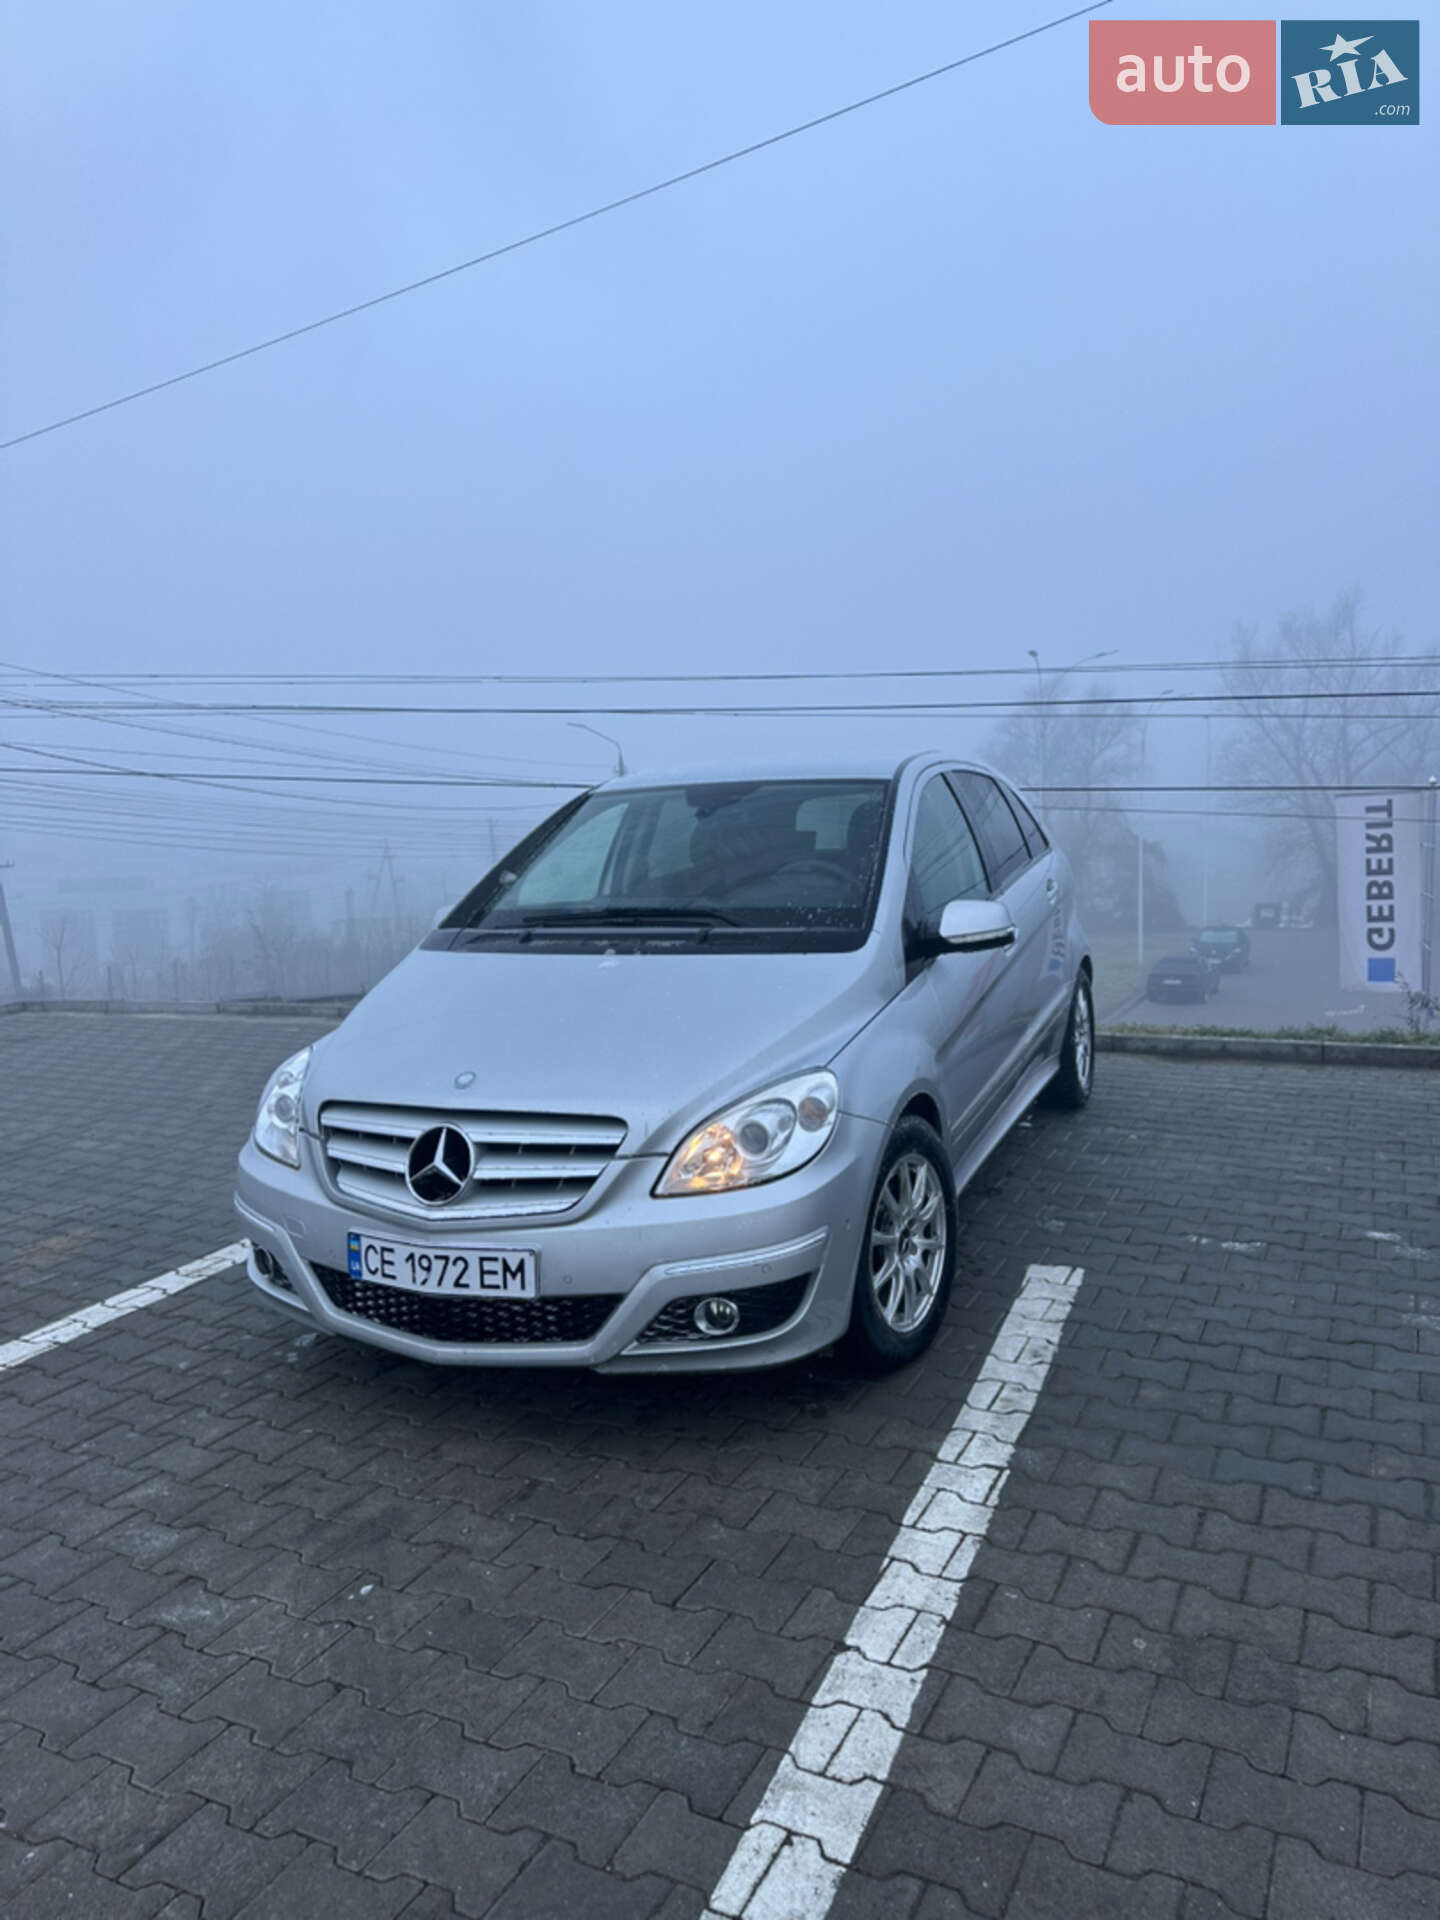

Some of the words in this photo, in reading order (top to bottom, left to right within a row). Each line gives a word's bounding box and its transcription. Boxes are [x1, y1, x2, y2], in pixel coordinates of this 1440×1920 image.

[364, 1244, 397, 1280] CE
[405, 1252, 470, 1288] 1972
[478, 1256, 526, 1291] EM
